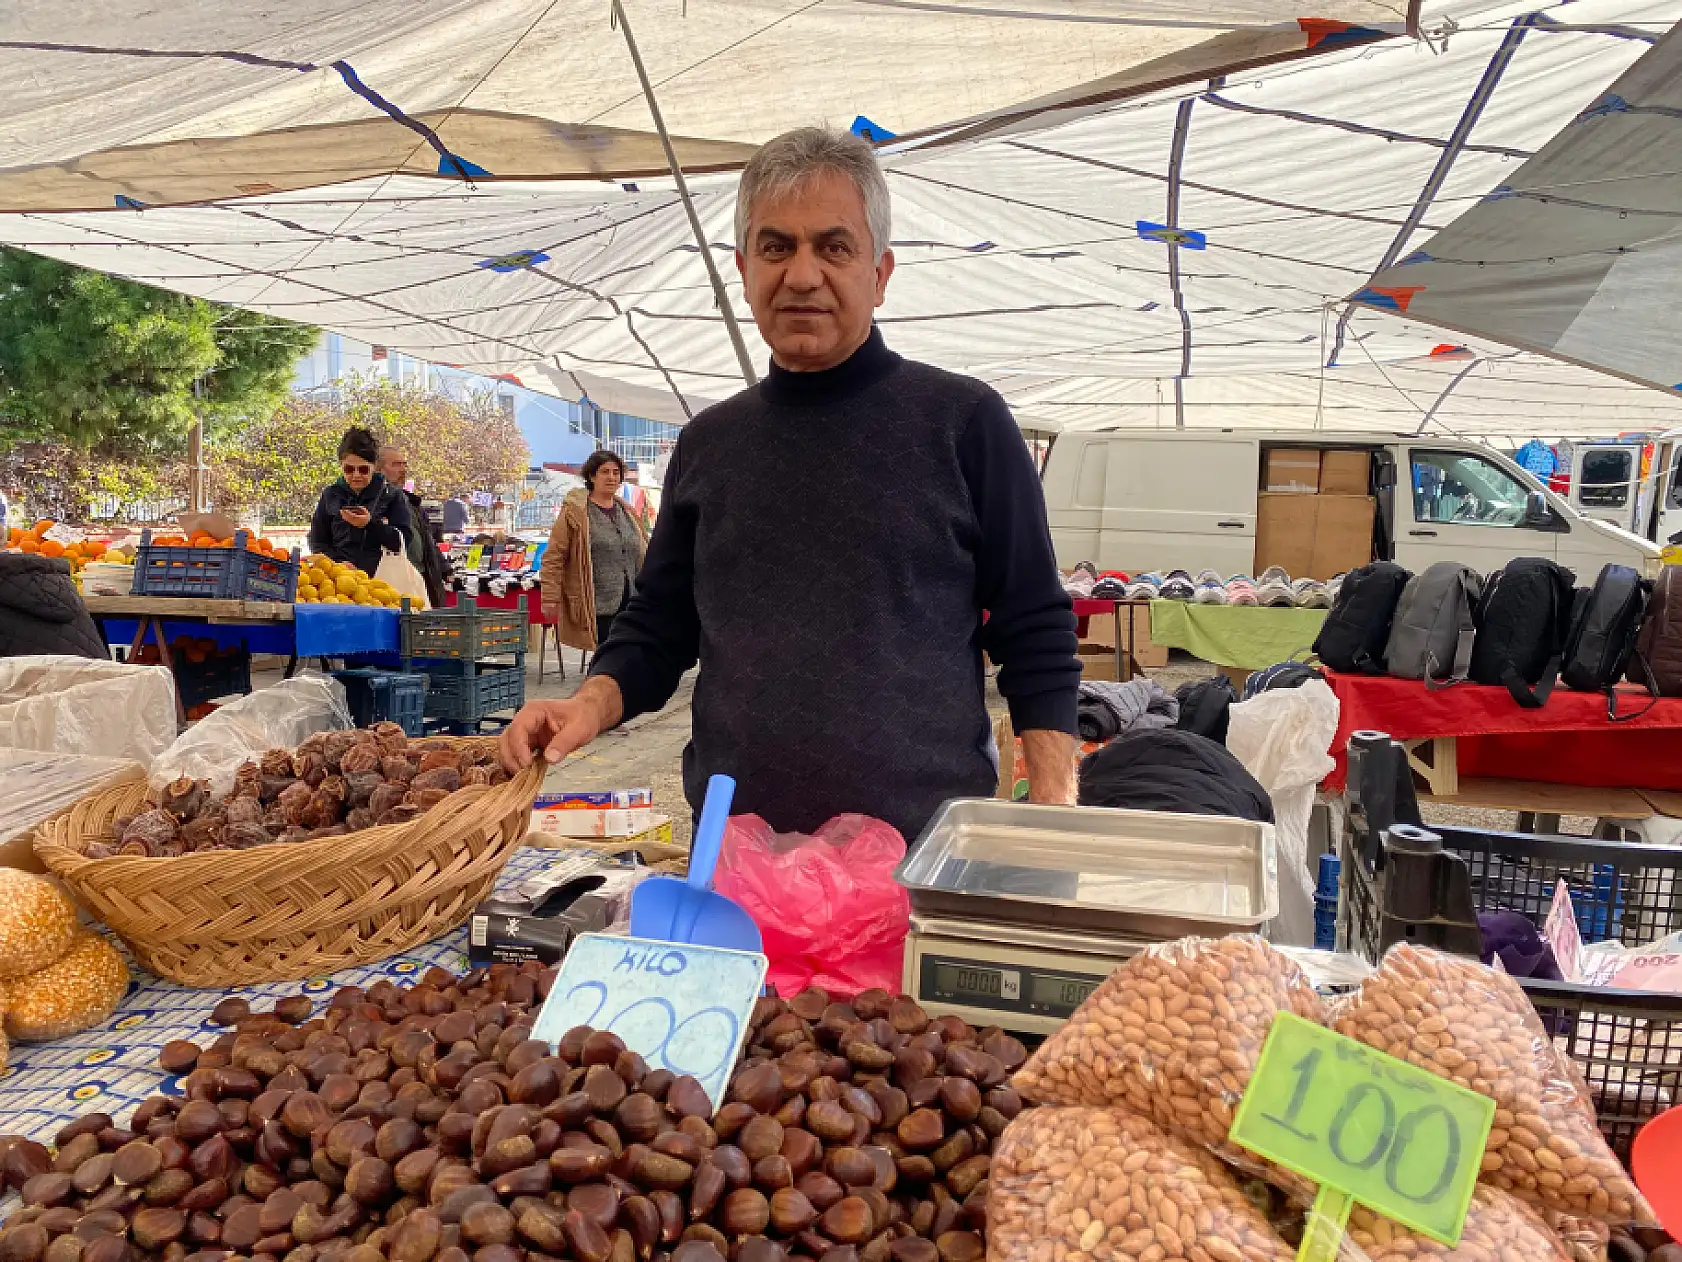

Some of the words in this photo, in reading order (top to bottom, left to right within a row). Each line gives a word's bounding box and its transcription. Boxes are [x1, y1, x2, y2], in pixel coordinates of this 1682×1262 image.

[566, 980, 739, 1081] 200
[1004, 978, 1018, 993] kg
[1260, 1047, 1462, 1204] 100
